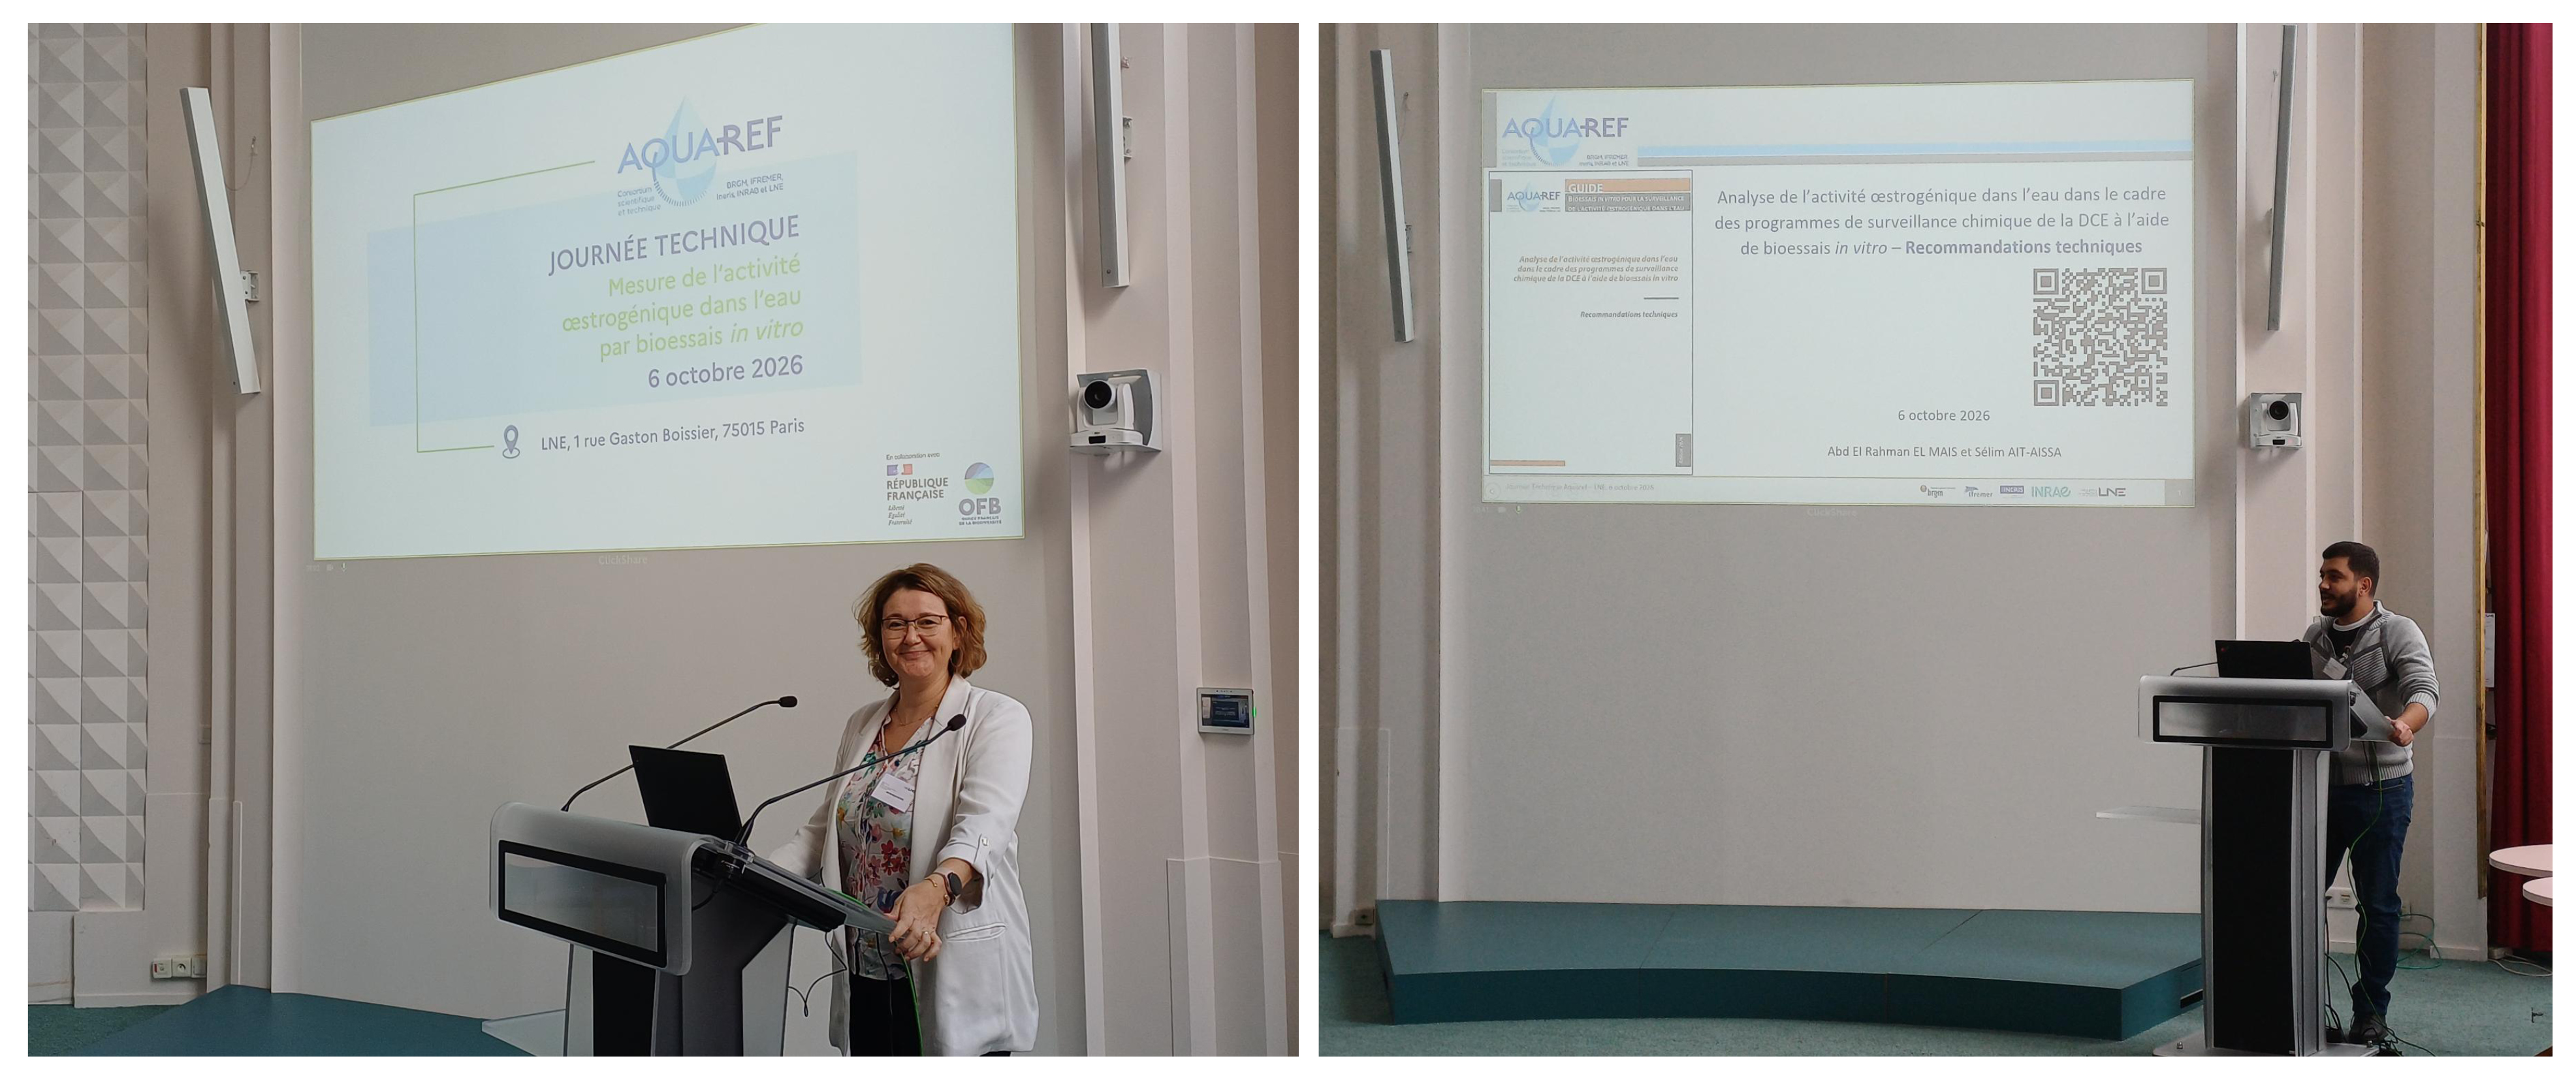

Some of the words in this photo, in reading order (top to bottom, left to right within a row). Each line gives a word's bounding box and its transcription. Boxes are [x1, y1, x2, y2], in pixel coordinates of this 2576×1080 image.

[769, 183, 784, 192] LNE
[1568, 183, 1603, 193] GUIDE
[1717, 190, 1775, 207] Analyse
[1779, 189, 1798, 204] de
[1803, 189, 1866, 204] l'activité
[1871, 188, 1977, 206] œstrogénique
[1982, 188, 2018, 202] dans
[2023, 187, 2059, 202] l'eau
[2064, 187, 2101, 201] dans
[2105, 187, 2118, 200] le
[2123, 186, 2166, 200] cadre
[627, 204, 661, 215] technique
[1715, 215, 1740, 230] des
[1745, 217, 1840, 232] programmes
[1845, 215, 1863, 229] de
[1868, 214, 1957, 229] surveillance
[1962, 214, 2032, 230] chimique
[2037, 214, 2056, 227] de
[2061, 213, 2073, 227] la
[2078, 213, 2108, 227] DCE
[2114, 212, 2122, 227] à
[2128, 212, 2169, 227] l'aide
[548, 234, 648, 276] JOURNÉE
[654, 214, 799, 257] TECHNIQUE
[1741, 241, 1759, 255] de
[1764, 241, 1831, 255] bioessais
[1835, 241, 1848, 255] in
[1853, 241, 1888, 255] vitro
[1905, 239, 2052, 255] Recommandations
[2056, 239, 2143, 256] techniques
[1519, 255, 1548, 264] Analyse
[609, 275, 676, 296] Mesure
[682, 266, 707, 288] de
[714, 252, 801, 283] l'activité
[1514, 274, 1546, 283] chimique
[562, 302, 693, 331] œstrogénique
[699, 295, 748, 317] dans
[754, 289, 802, 310] l'eau
[1642, 310, 1678, 319] techniques
[600, 338, 630, 362] par
[637, 326, 723, 353] bioessais
[730, 323, 748, 343] in
[756, 319, 804, 340] vitro
[648, 369, 660, 388] 6
[665, 362, 745, 387] octobre
[751, 355, 804, 379] 2026
[1898, 410, 1905, 421] 6
[1909, 409, 1956, 421] octobre
[1960, 410, 1990, 421] 2026
[541, 435, 571, 452] LNE,
[573, 434, 580, 448] 1
[584, 436, 605, 447] rue
[609, 430, 658, 446] Gaston
[663, 424, 719, 442] Boissier,
[722, 421, 765, 438] 75015
[770, 418, 805, 434] Paris
[1827, 446, 1849, 457] Abd
[1852, 446, 1862, 457] El
[1866, 446, 1910, 457] Rahman
[1913, 447, 1926, 457] EL
[1929, 447, 1958, 457] MAIS
[1961, 448, 1972, 457] et
[1975, 446, 2005, 457] Sélim
[2008, 447, 2062, 458] AIT-AISSA
[887, 477, 949, 490] RÉPUBLIQUE
[887, 490, 944, 501] FRANÇAISE
[1927, 488, 1943, 498] brgm
[2099, 487, 2126, 497] LNE
[959, 498, 1002, 516] OFB
